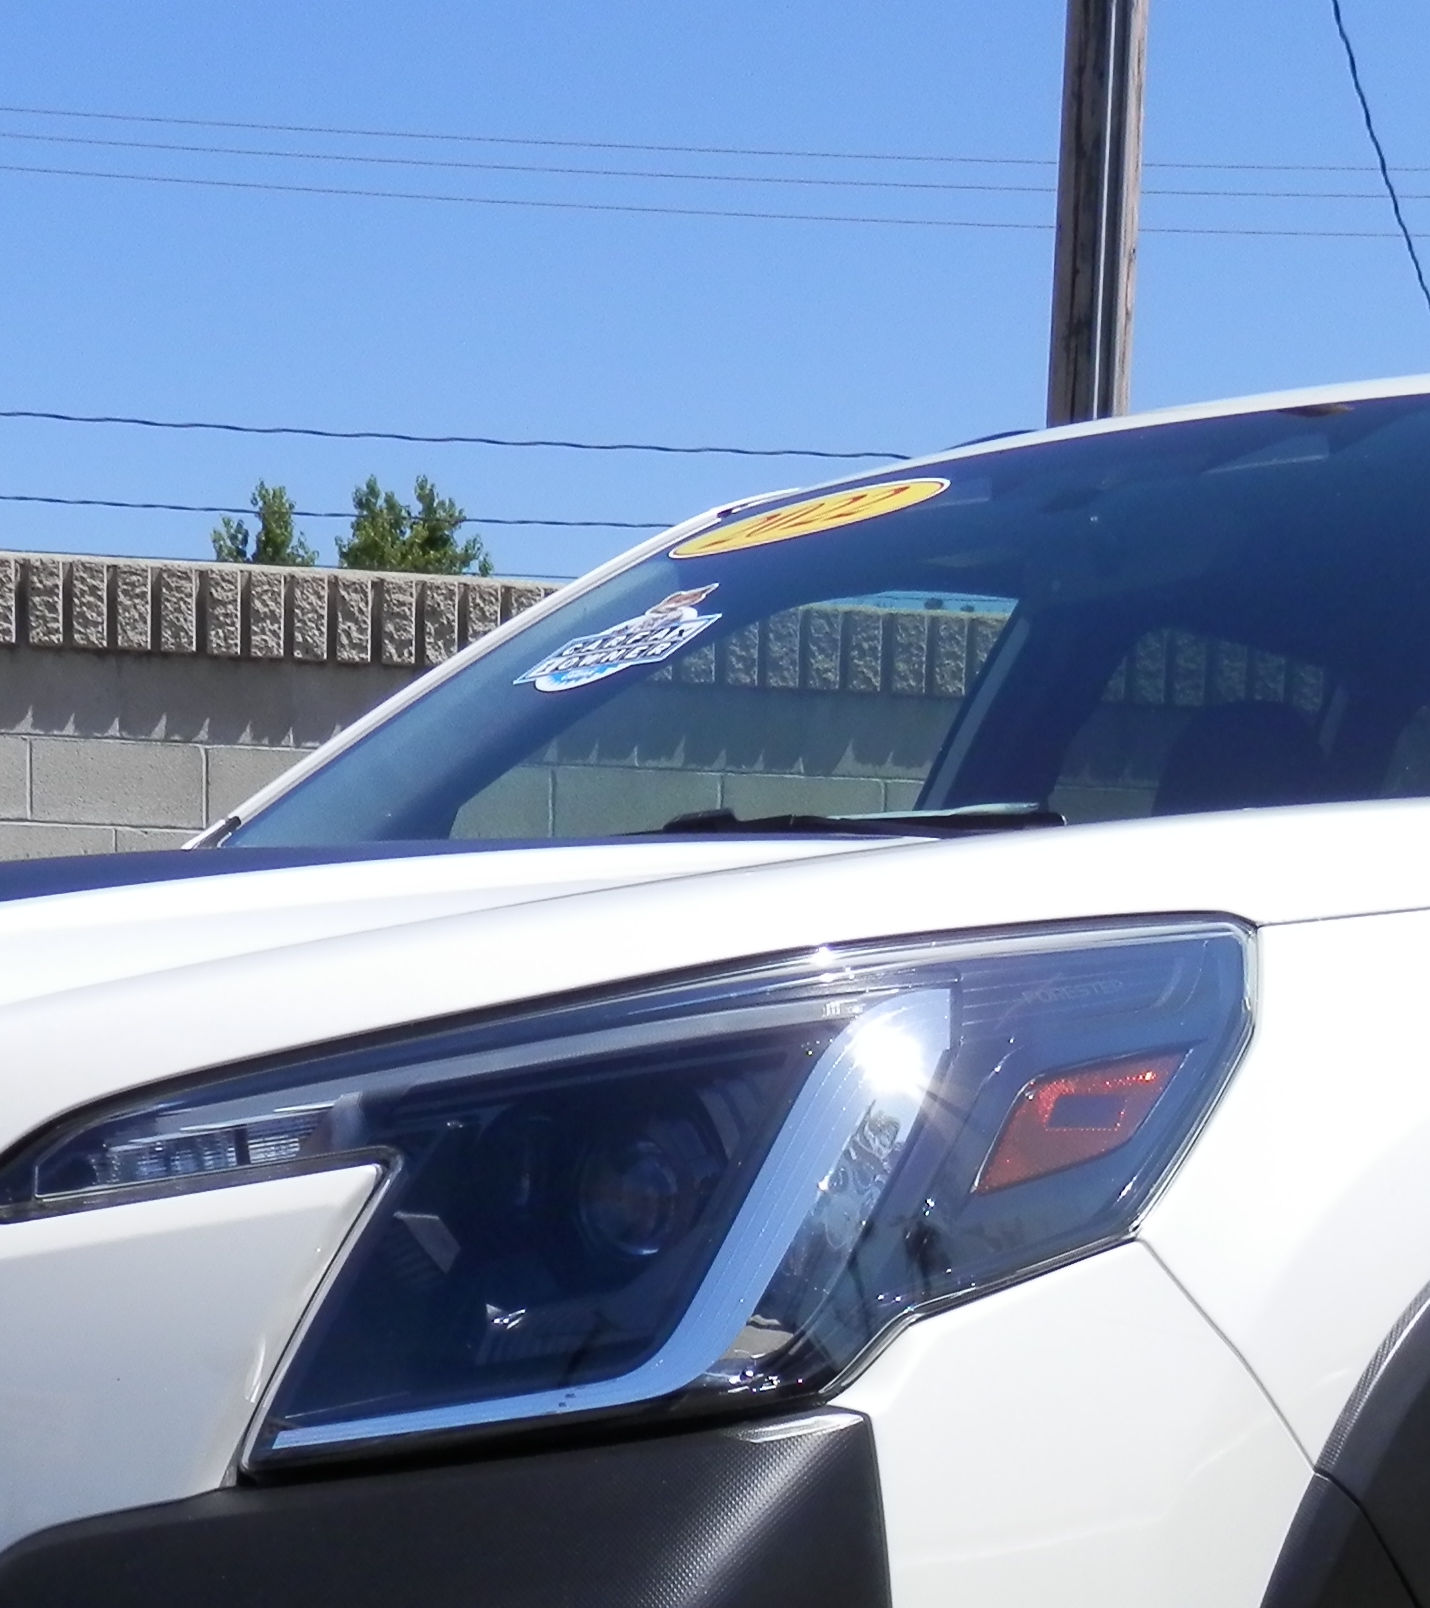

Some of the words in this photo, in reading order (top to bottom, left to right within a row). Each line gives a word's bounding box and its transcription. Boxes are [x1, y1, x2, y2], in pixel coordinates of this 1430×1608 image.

[698, 485, 911, 549] 2022
[561, 622, 699, 657] CARFAX
[1021, 979, 1123, 1004] FORESTER
